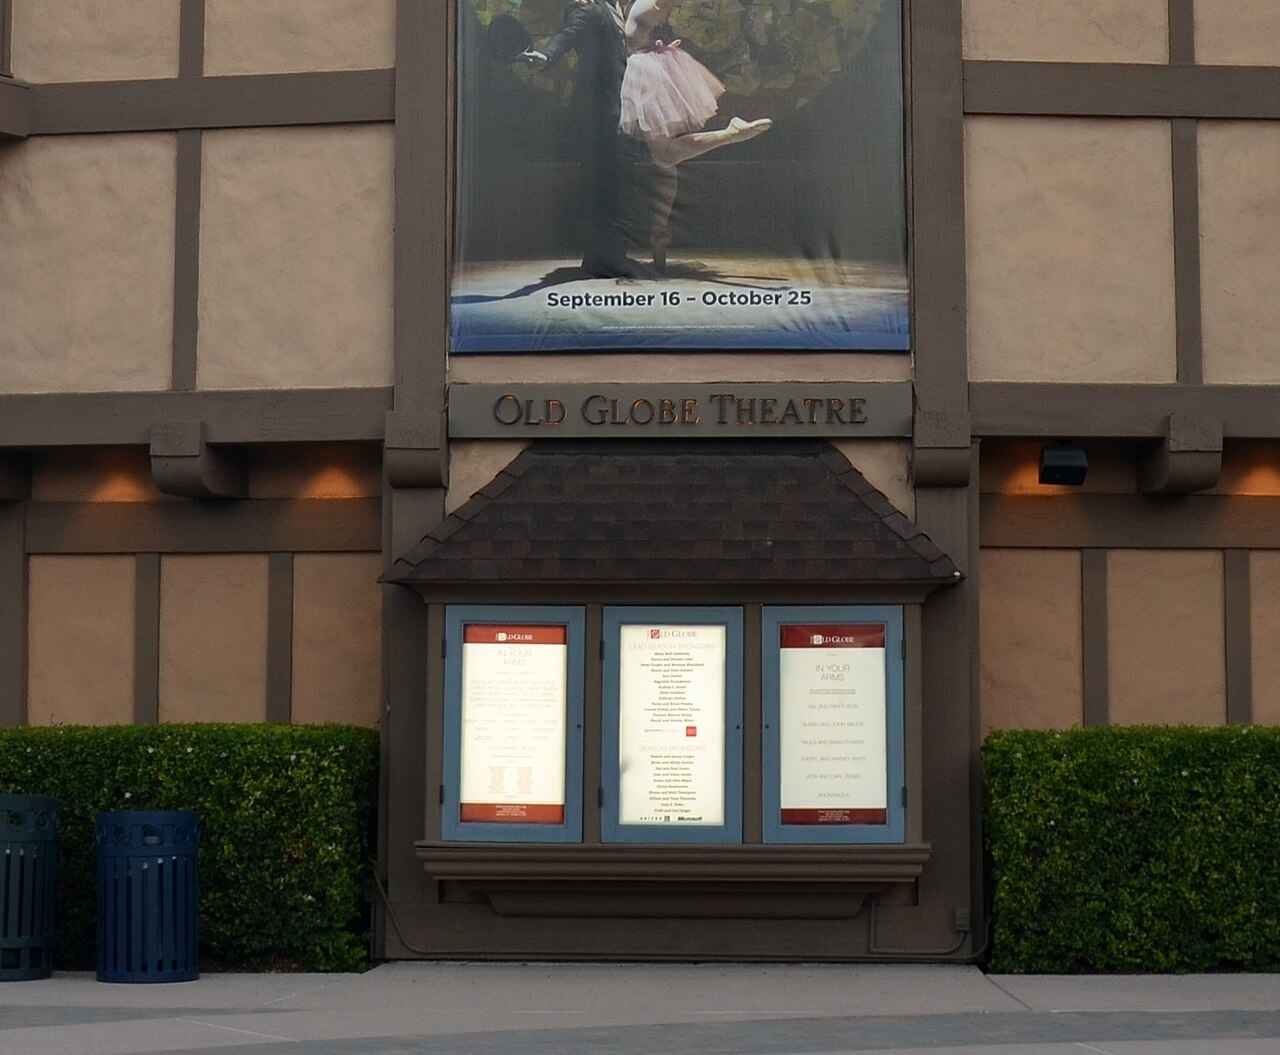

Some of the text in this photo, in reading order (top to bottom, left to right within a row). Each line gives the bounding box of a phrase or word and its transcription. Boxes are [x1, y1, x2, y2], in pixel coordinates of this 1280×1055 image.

[547, 291, 655, 309] September
[660, 291, 680, 306] 16
[702, 290, 783, 306] October
[787, 290, 812, 306] 25
[493, 393, 868, 426] OLD GLOBE THEATRE
[815, 664, 850, 673] IN YOUR
[820, 673, 845, 682] ARMS
